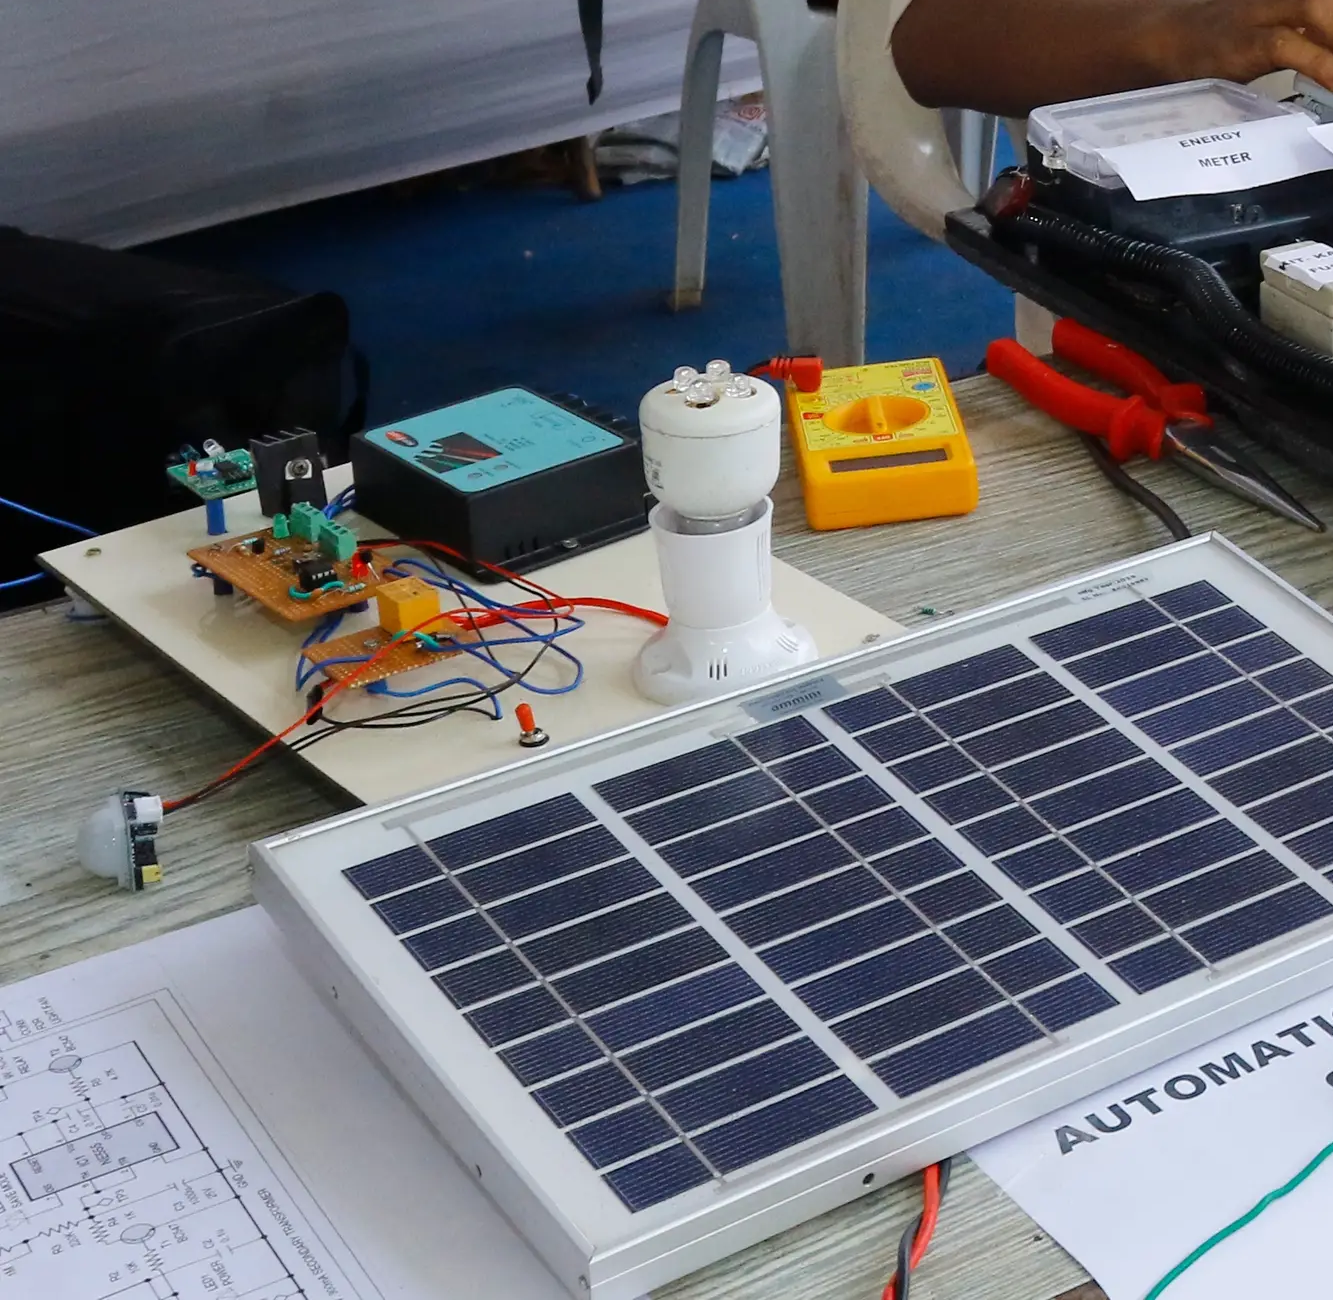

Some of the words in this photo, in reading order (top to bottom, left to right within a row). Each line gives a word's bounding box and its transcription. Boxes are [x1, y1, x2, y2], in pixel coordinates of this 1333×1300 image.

[1179, 130, 1242, 149] ENERGY
[1198, 151, 1252, 169] METER
[74, 1155, 90, 1168] IC1
[89, 1142, 112, 1166] NE555
[26, 1157, 43, 1175] RESET
[232, 1173, 249, 1189] GND
[257, 1187, 295, 1236] TRANSFORMER
[168, 1223, 189, 1244] BC547
[202, 1238, 215, 1250] C2
[291, 1235, 324, 1276] SECONDARY
[210, 1260, 234, 1287] POWER
[201, 1274, 219, 1292] LED1
